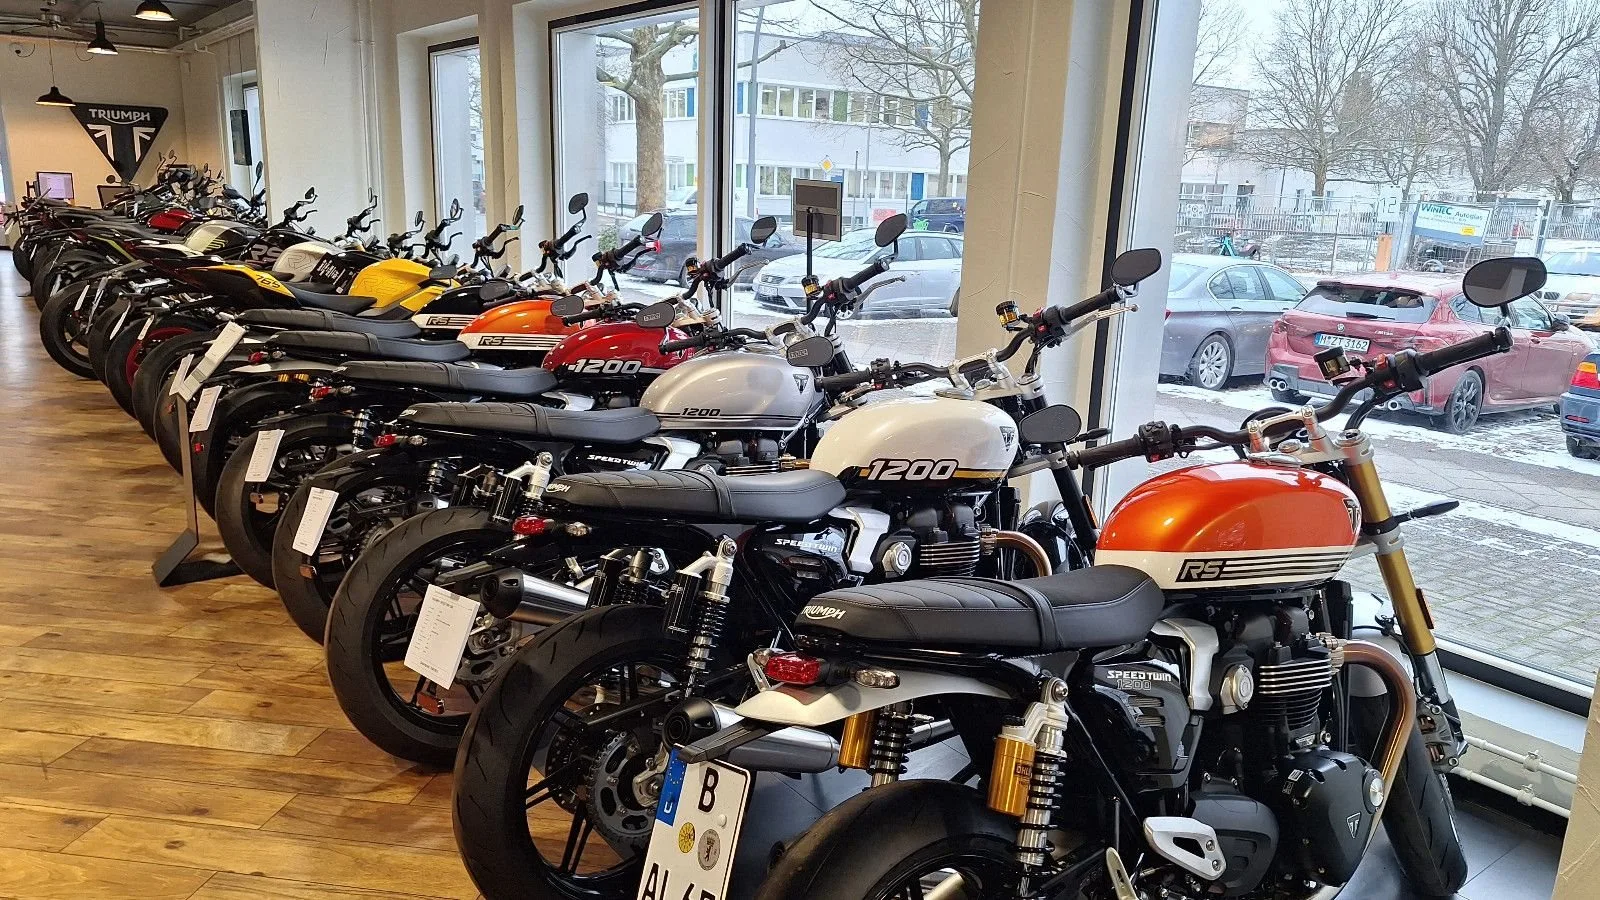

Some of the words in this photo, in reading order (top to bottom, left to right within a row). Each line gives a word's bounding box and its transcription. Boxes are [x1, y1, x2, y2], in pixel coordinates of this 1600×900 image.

[88, 108, 151, 124] TRIUMPH
[1379, 196, 1397, 213] 12
[255, 274, 281, 289] 765
[428, 316, 449, 326] RS
[479, 336, 503, 346] RS
[1320, 335, 1327, 345] M
[1331, 336, 1342, 348] ZT
[1344, 340, 1369, 351] 3162
[573, 358, 642, 374] 1200
[681, 407, 721, 417] 1200
[587, 454, 621, 464] SPEED
[867, 459, 959, 481] 1200
[774, 538, 813, 548] SPEED
[814, 543, 838, 552] TWIN
[1179, 560, 1224, 580] RS
[800, 605, 847, 620] TRIUMPH
[1107, 670, 1146, 680] SPEED
[1146, 672, 1172, 682] TWIN
[1116, 679, 1152, 691] 1200
[698, 766, 720, 813] B
